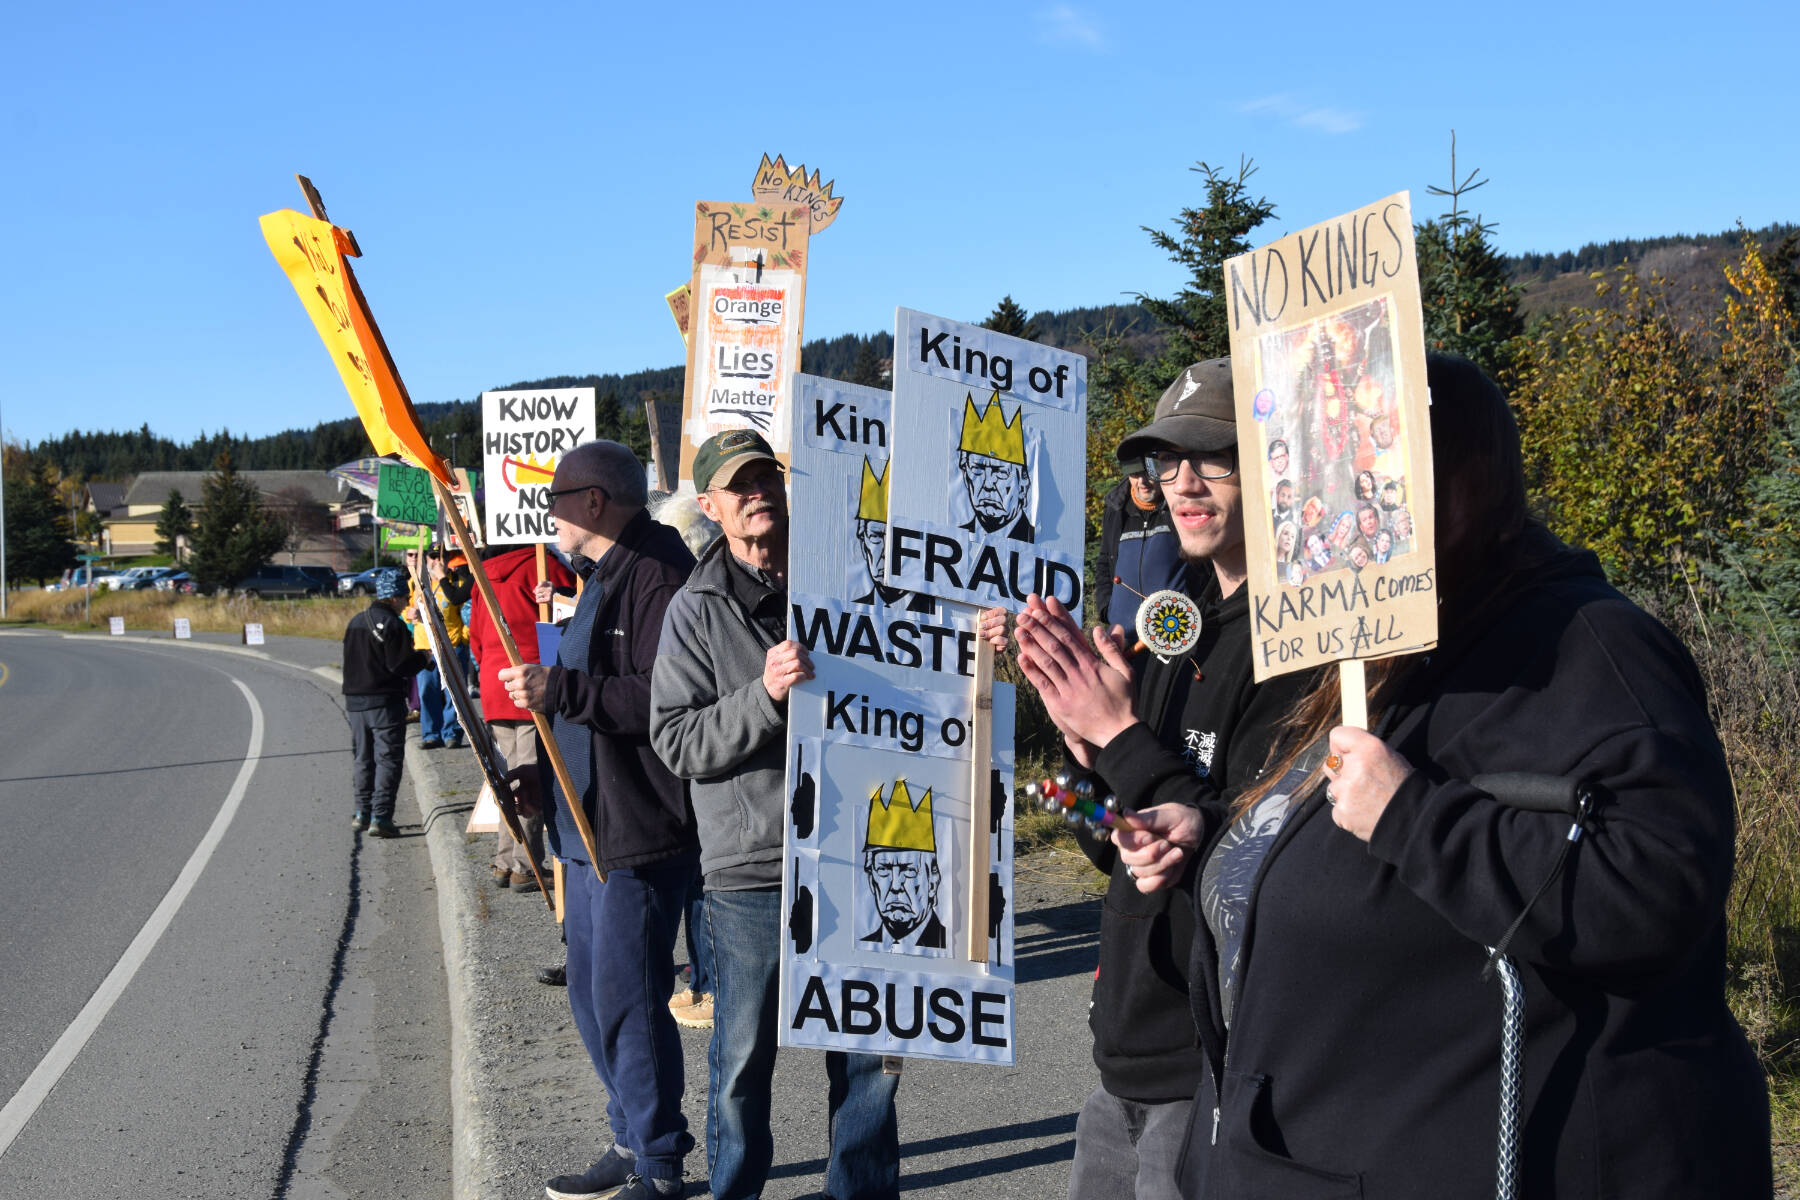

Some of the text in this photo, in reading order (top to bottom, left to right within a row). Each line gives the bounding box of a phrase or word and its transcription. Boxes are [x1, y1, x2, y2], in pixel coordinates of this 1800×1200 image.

[760, 169, 829, 223] NO KINGS
[1230, 203, 1404, 331] NO KINGS
[714, 297, 782, 318] Orange
[718, 345, 775, 373] Lies
[919, 327, 1069, 400] King of
[498, 395, 579, 423] KNOW
[711, 388, 776, 407] Matter
[485, 427, 585, 456] HISTORY
[815, 399, 886, 448] Kin
[388, 478, 433, 495] REVOL
[518, 486, 552, 510] NO
[376, 504, 437, 522] NO KING
[890, 526, 1081, 612] FRAUD
[1255, 573, 1370, 635] KARMA
[1262, 614, 1404, 668] FOR US ALL
[826, 690, 975, 752] King o
[791, 974, 1008, 1048] ABUSE
